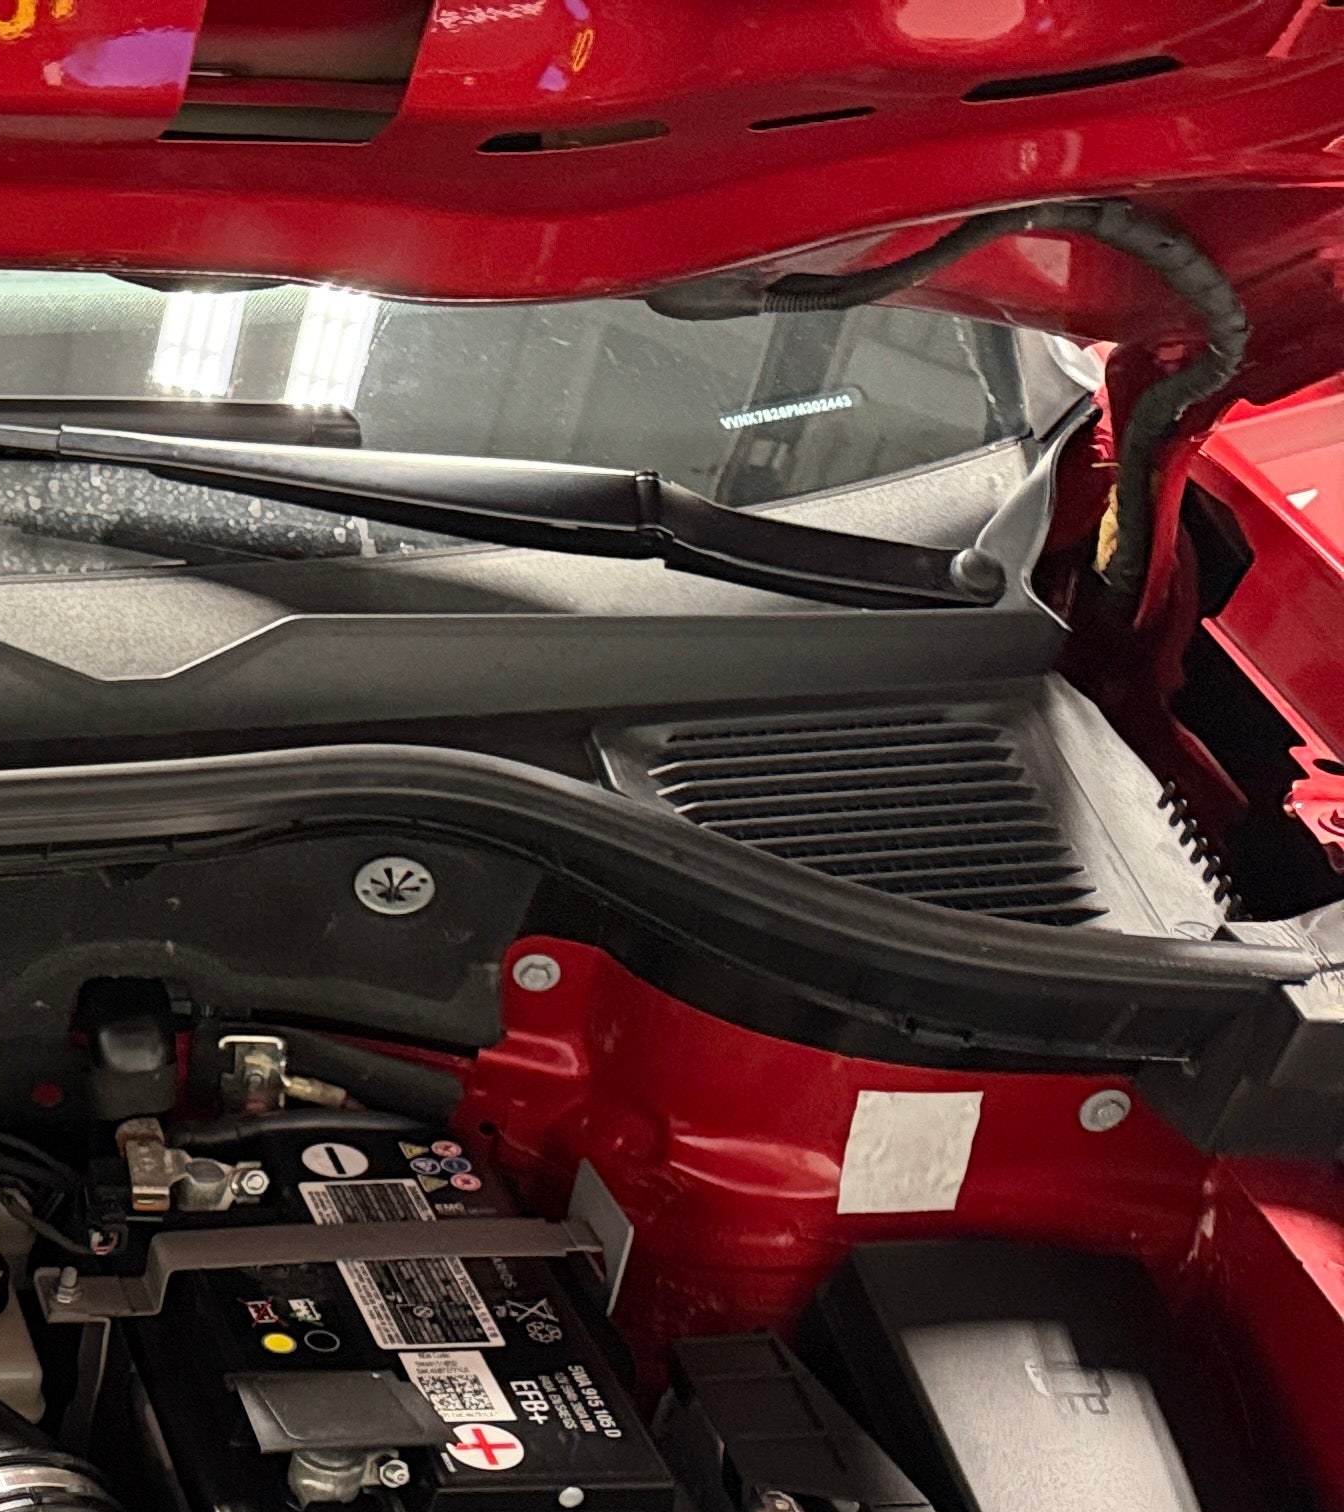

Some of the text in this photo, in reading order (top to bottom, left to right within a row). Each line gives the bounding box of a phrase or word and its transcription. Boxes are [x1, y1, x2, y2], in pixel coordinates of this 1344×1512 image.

[509, 1379, 550, 1425] EFB+
[581, 1387, 605, 1409] 915
[593, 1409, 618, 1428] 105
[603, 1429, 622, 1439] D
